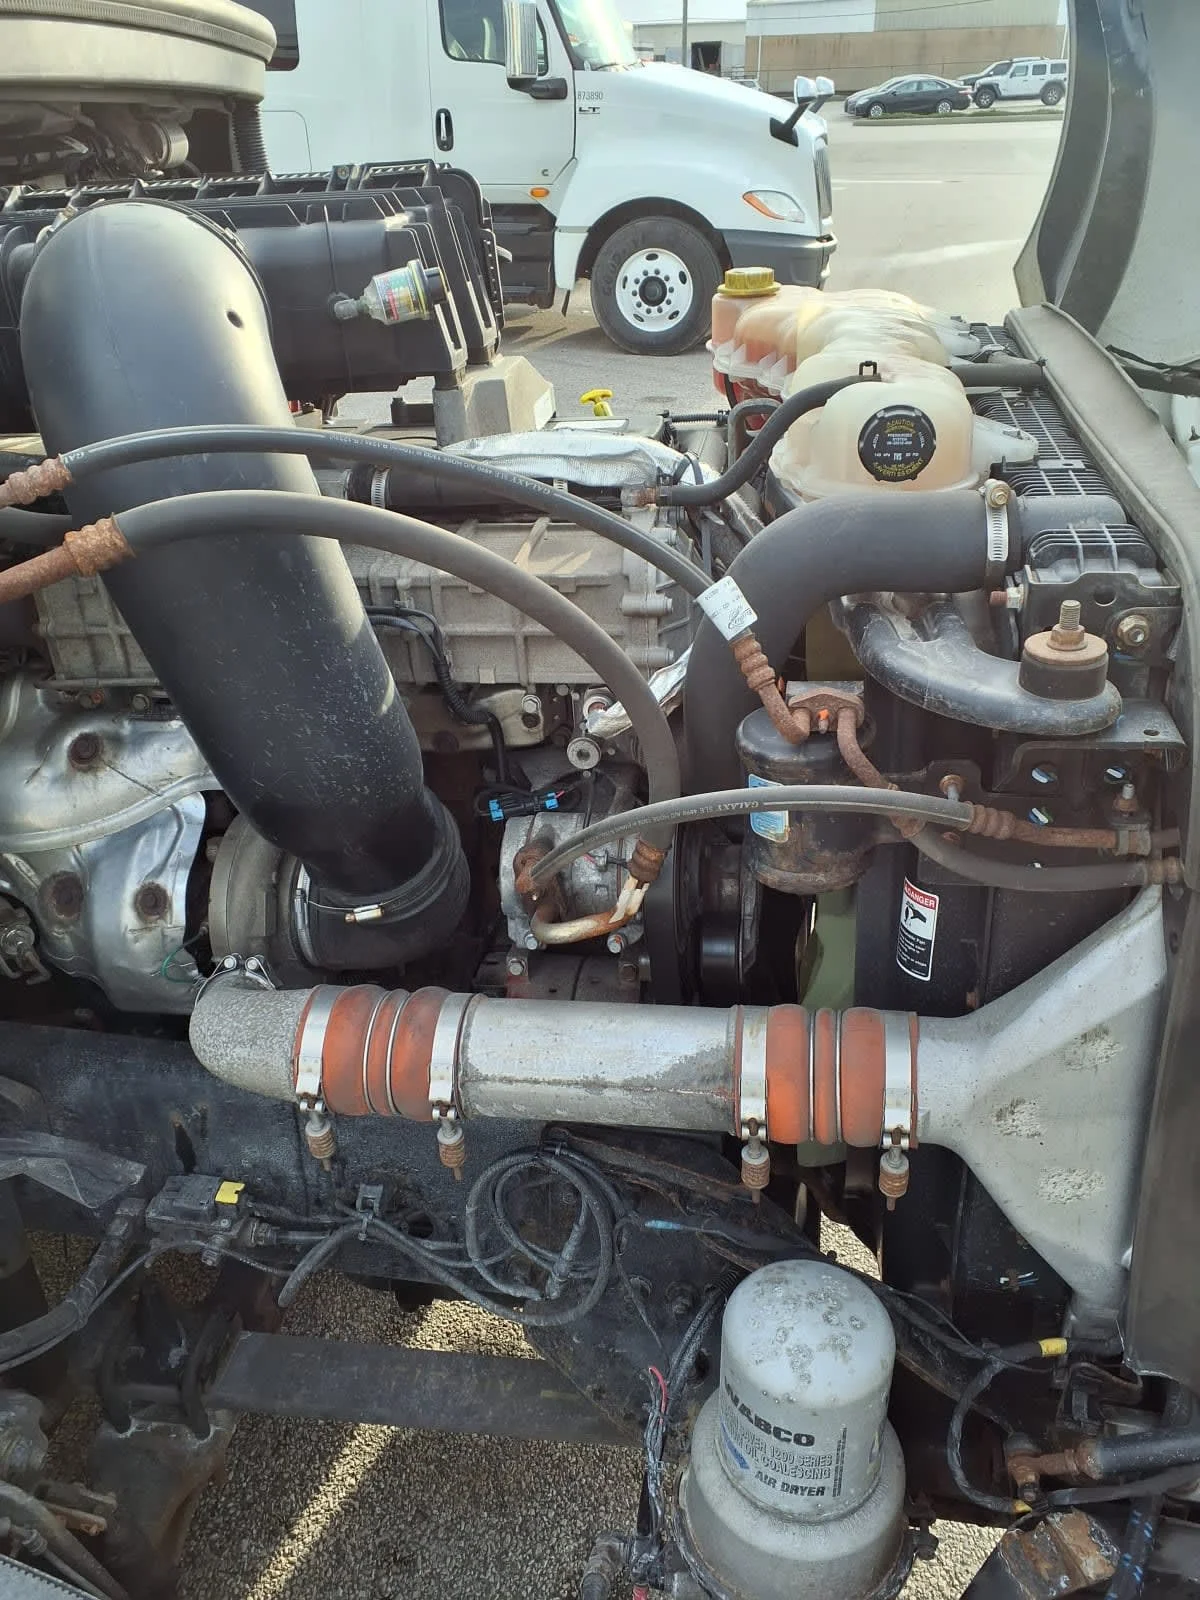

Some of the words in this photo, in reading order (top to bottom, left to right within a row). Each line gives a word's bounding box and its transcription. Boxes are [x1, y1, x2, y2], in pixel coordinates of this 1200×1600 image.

[509, 475, 552, 496] GALAXY
[717, 800, 760, 813] GALAXY
[908, 889, 935, 908] DANGER
[724, 1376, 816, 1447] WABCO
[760, 1454, 831, 1480] COALESCING
[770, 1445, 795, 1465] 1200
[798, 1454, 833, 1467] SERIES
[754, 1470, 777, 1489] AIR
[780, 1481, 826, 1498] DRYER
